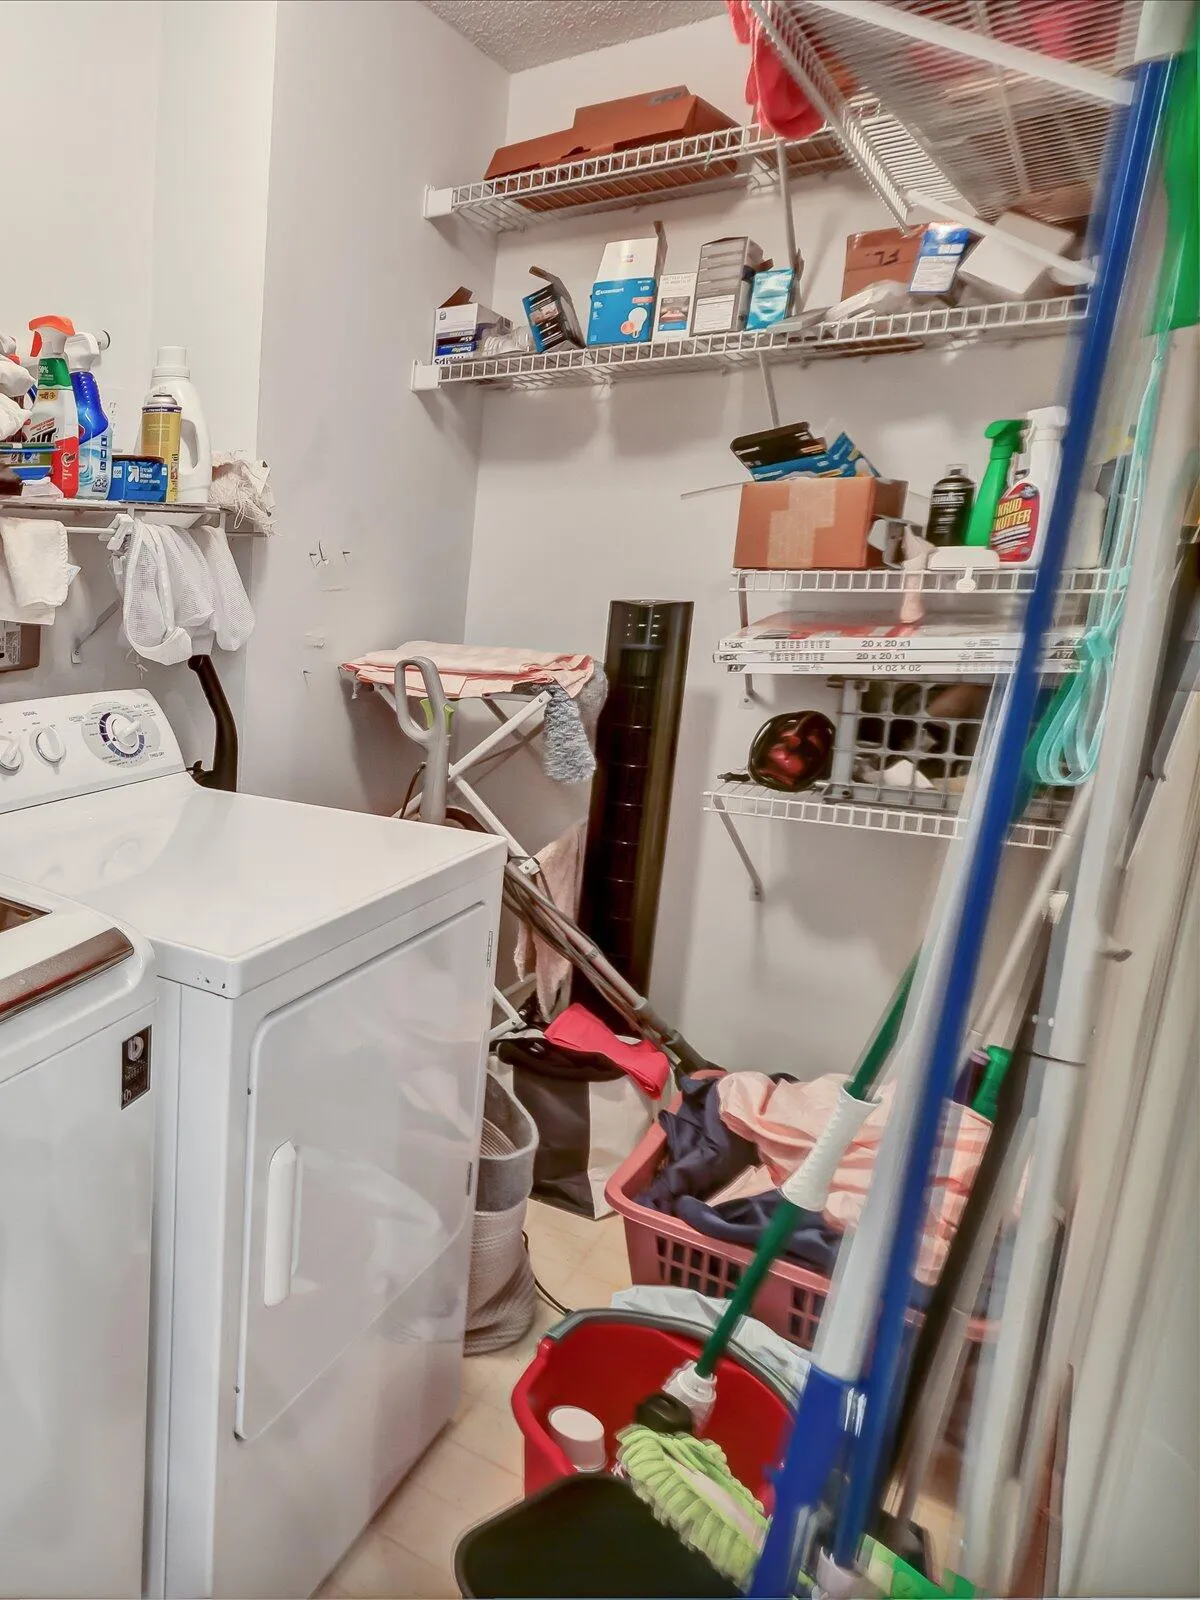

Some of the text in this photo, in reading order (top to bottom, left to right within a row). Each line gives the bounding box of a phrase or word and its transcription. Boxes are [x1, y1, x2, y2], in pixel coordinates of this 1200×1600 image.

[997, 498, 1022, 518] KRUD
[861, 640, 874, 648] 20
[884, 640, 898, 648] 20
[885, 664, 898, 672] 20
[909, 664, 921, 672] 20
